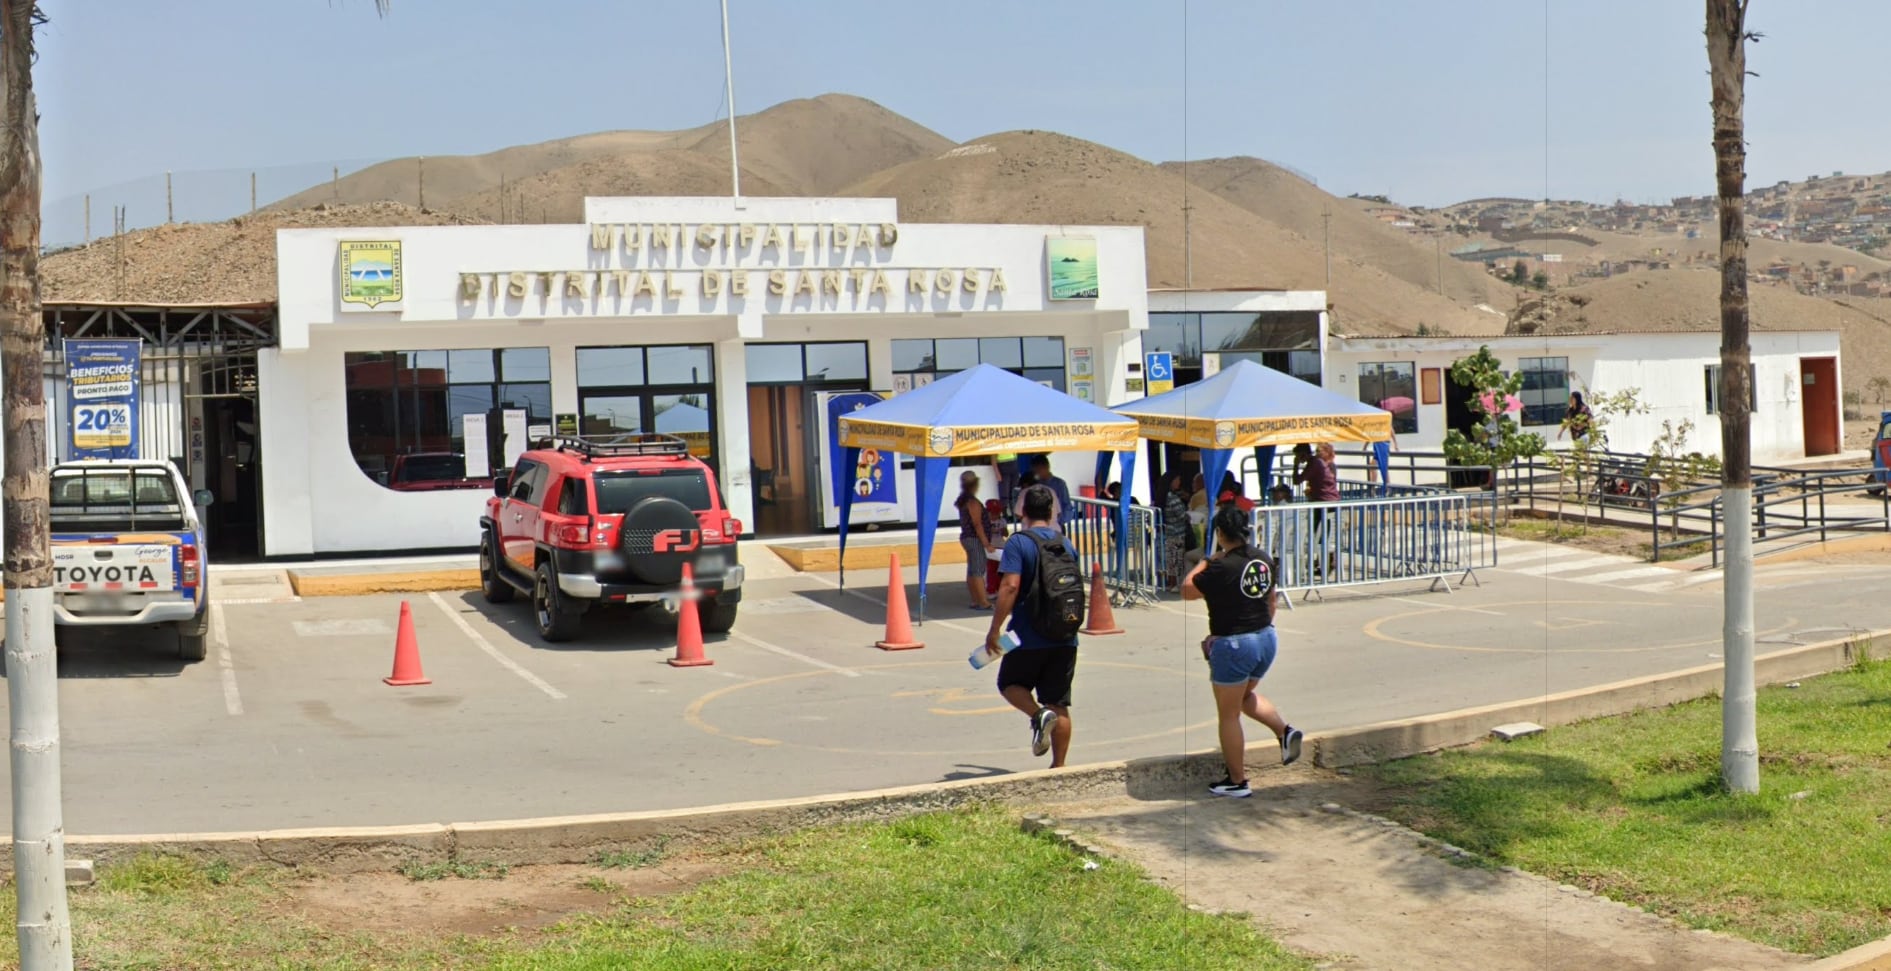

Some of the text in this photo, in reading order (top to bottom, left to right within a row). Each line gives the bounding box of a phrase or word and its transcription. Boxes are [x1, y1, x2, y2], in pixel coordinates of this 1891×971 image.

[591, 222, 898, 250] MUNICIPALIDAD
[460, 267, 1008, 299] DISTRITAL DE SANTA ROSA
[70, 364, 134, 379] BENEFICIOS
[72, 374, 132, 386] TRIBUTARIOS
[77, 385, 129, 395] PRONTO PAGO
[956, 424, 1095, 440] MUNICIPALIDAD DE SANTA ROSA
[1238, 419, 1297, 433] MUNICIPALIDAD
[1300, 418, 1310, 429] DE
[1310, 417, 1333, 428] SANTA
[653, 528, 699, 553] FJ
[53, 565, 155, 582] TOYOTA
